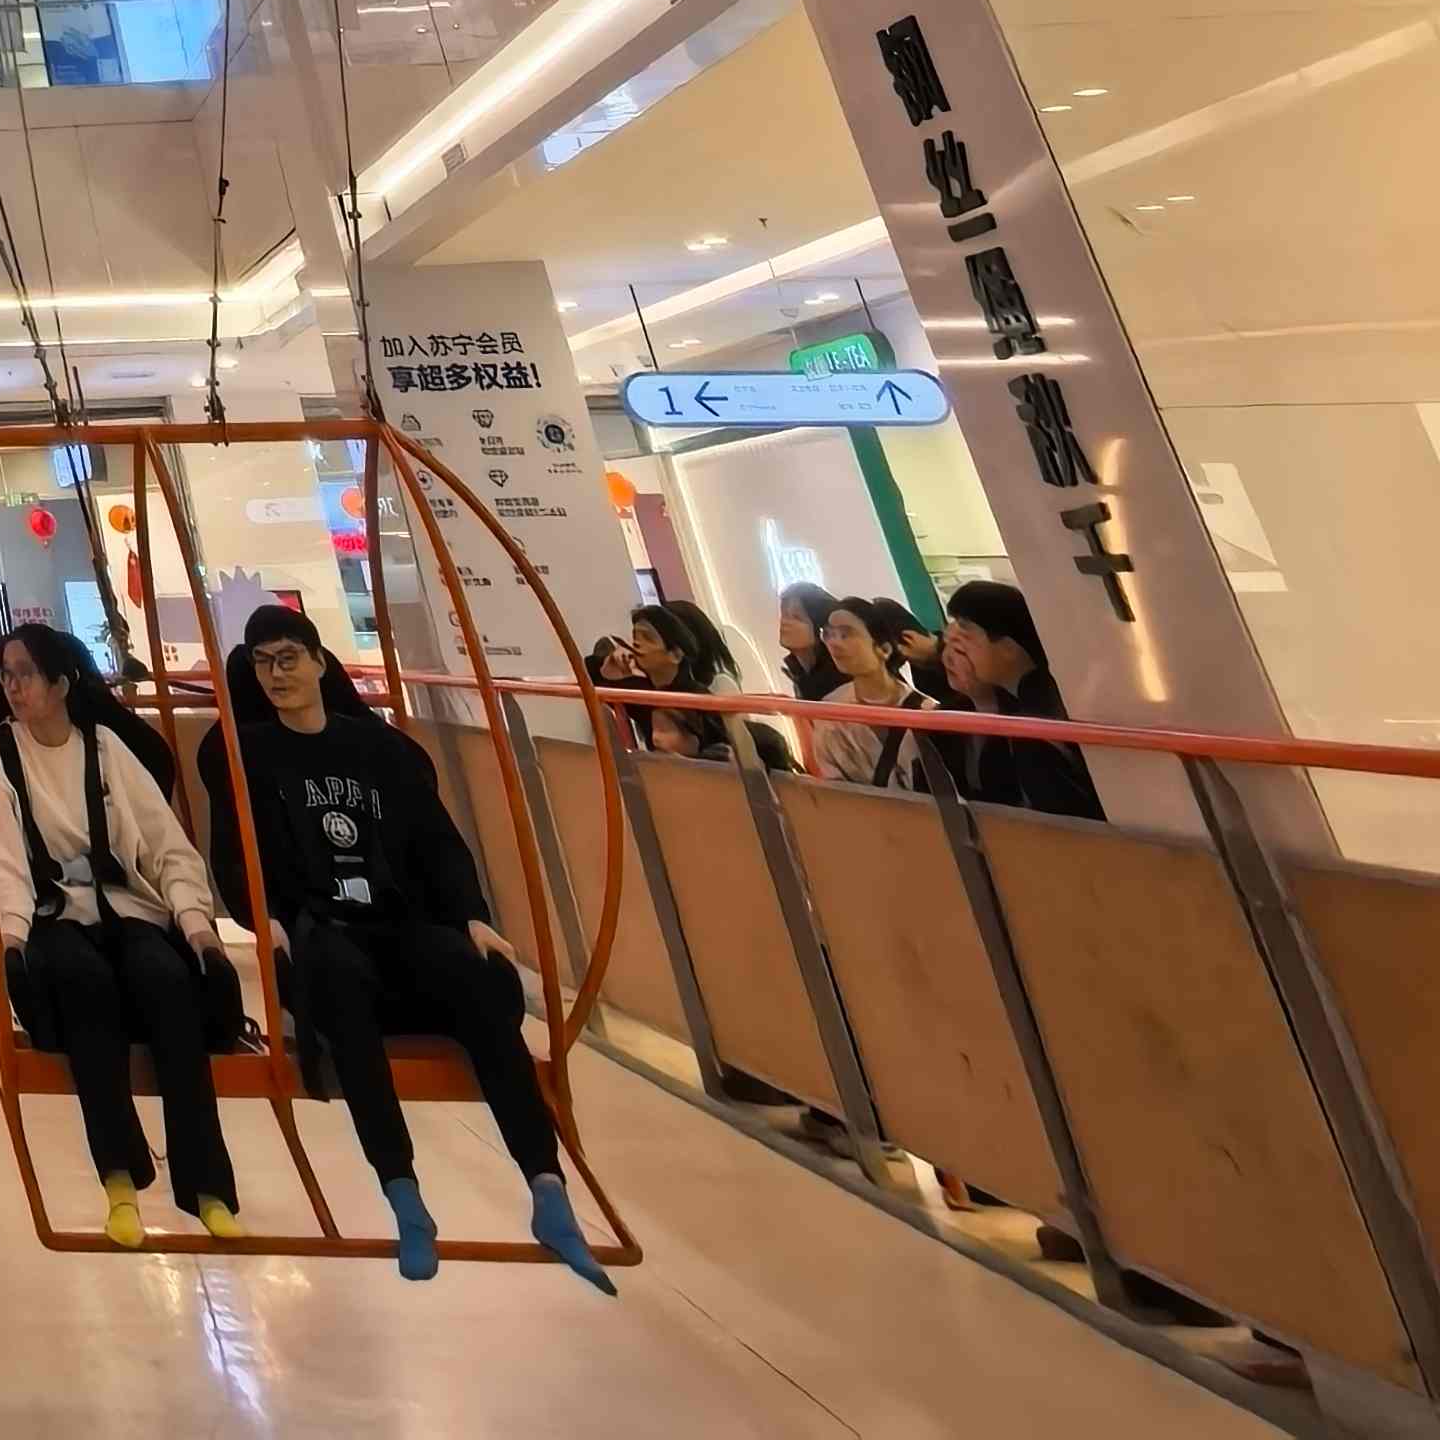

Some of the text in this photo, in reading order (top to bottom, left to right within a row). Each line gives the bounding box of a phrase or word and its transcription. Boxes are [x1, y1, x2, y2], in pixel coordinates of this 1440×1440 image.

[380, 331, 525, 358] 加入苏宁会员
[387, 360, 543, 394] 享超多权益!
[657, 386, 684, 416] 1
